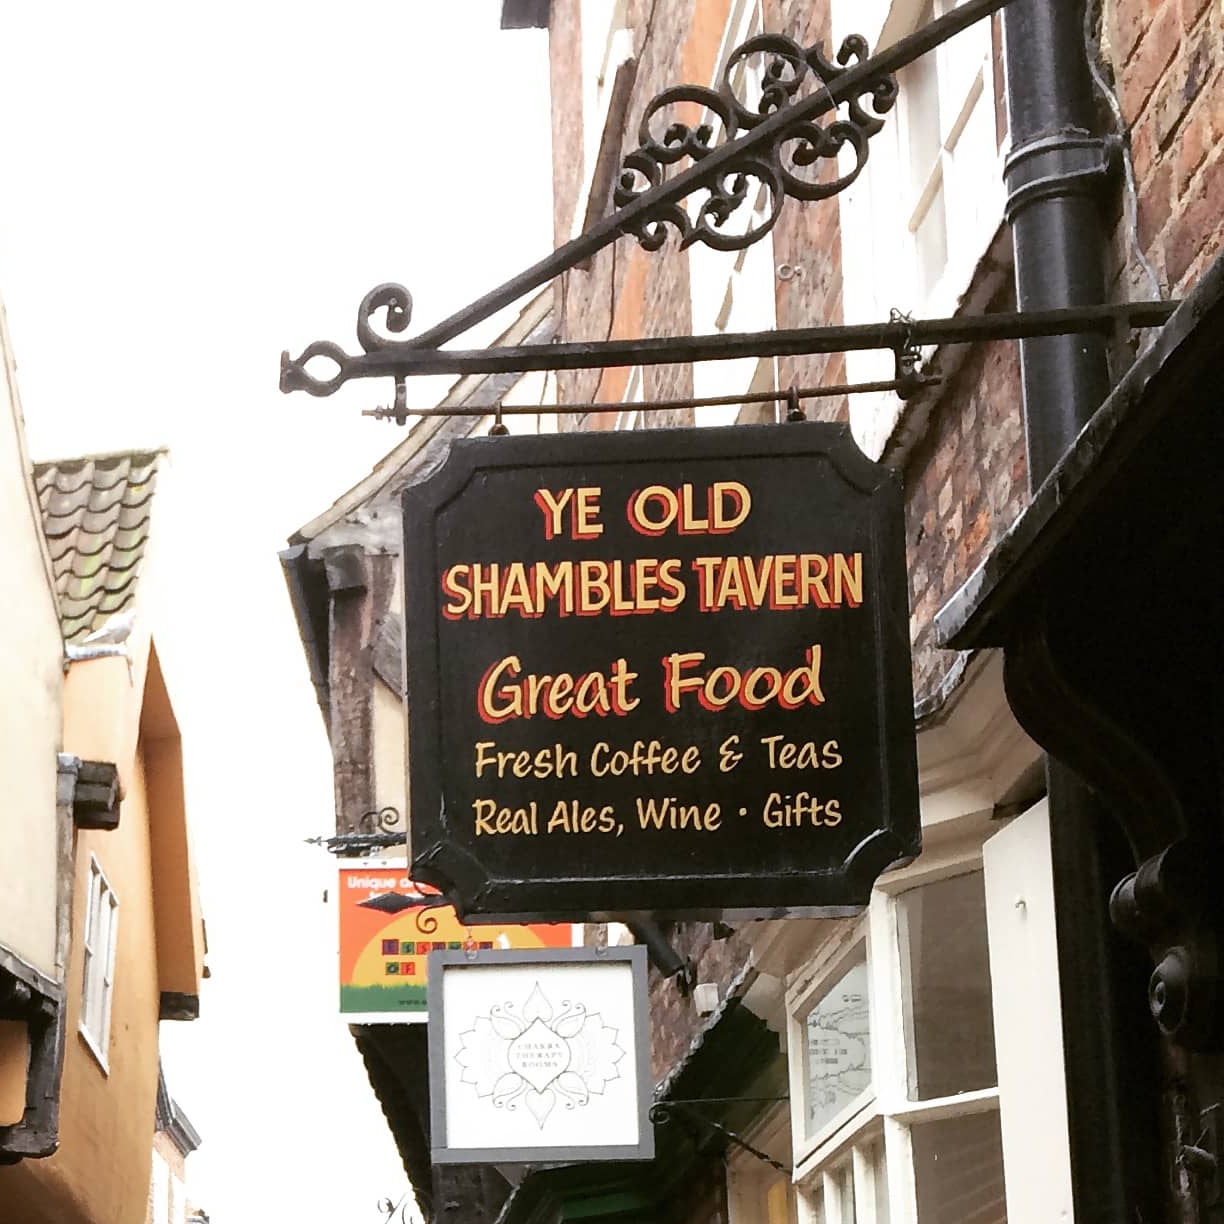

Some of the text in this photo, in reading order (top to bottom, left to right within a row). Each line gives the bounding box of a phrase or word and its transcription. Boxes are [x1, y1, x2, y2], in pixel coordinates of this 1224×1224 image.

[535, 481, 752, 540] YE OLD
[442, 552, 864, 619] SHAMBLES TAVERN
[478, 644, 826, 725] Great Food
[474, 734, 843, 779] Fresh Coffee & Teas
[472, 792, 843, 838] Real Ales, Wine Gifts
[347, 876, 397, 890] Unique
